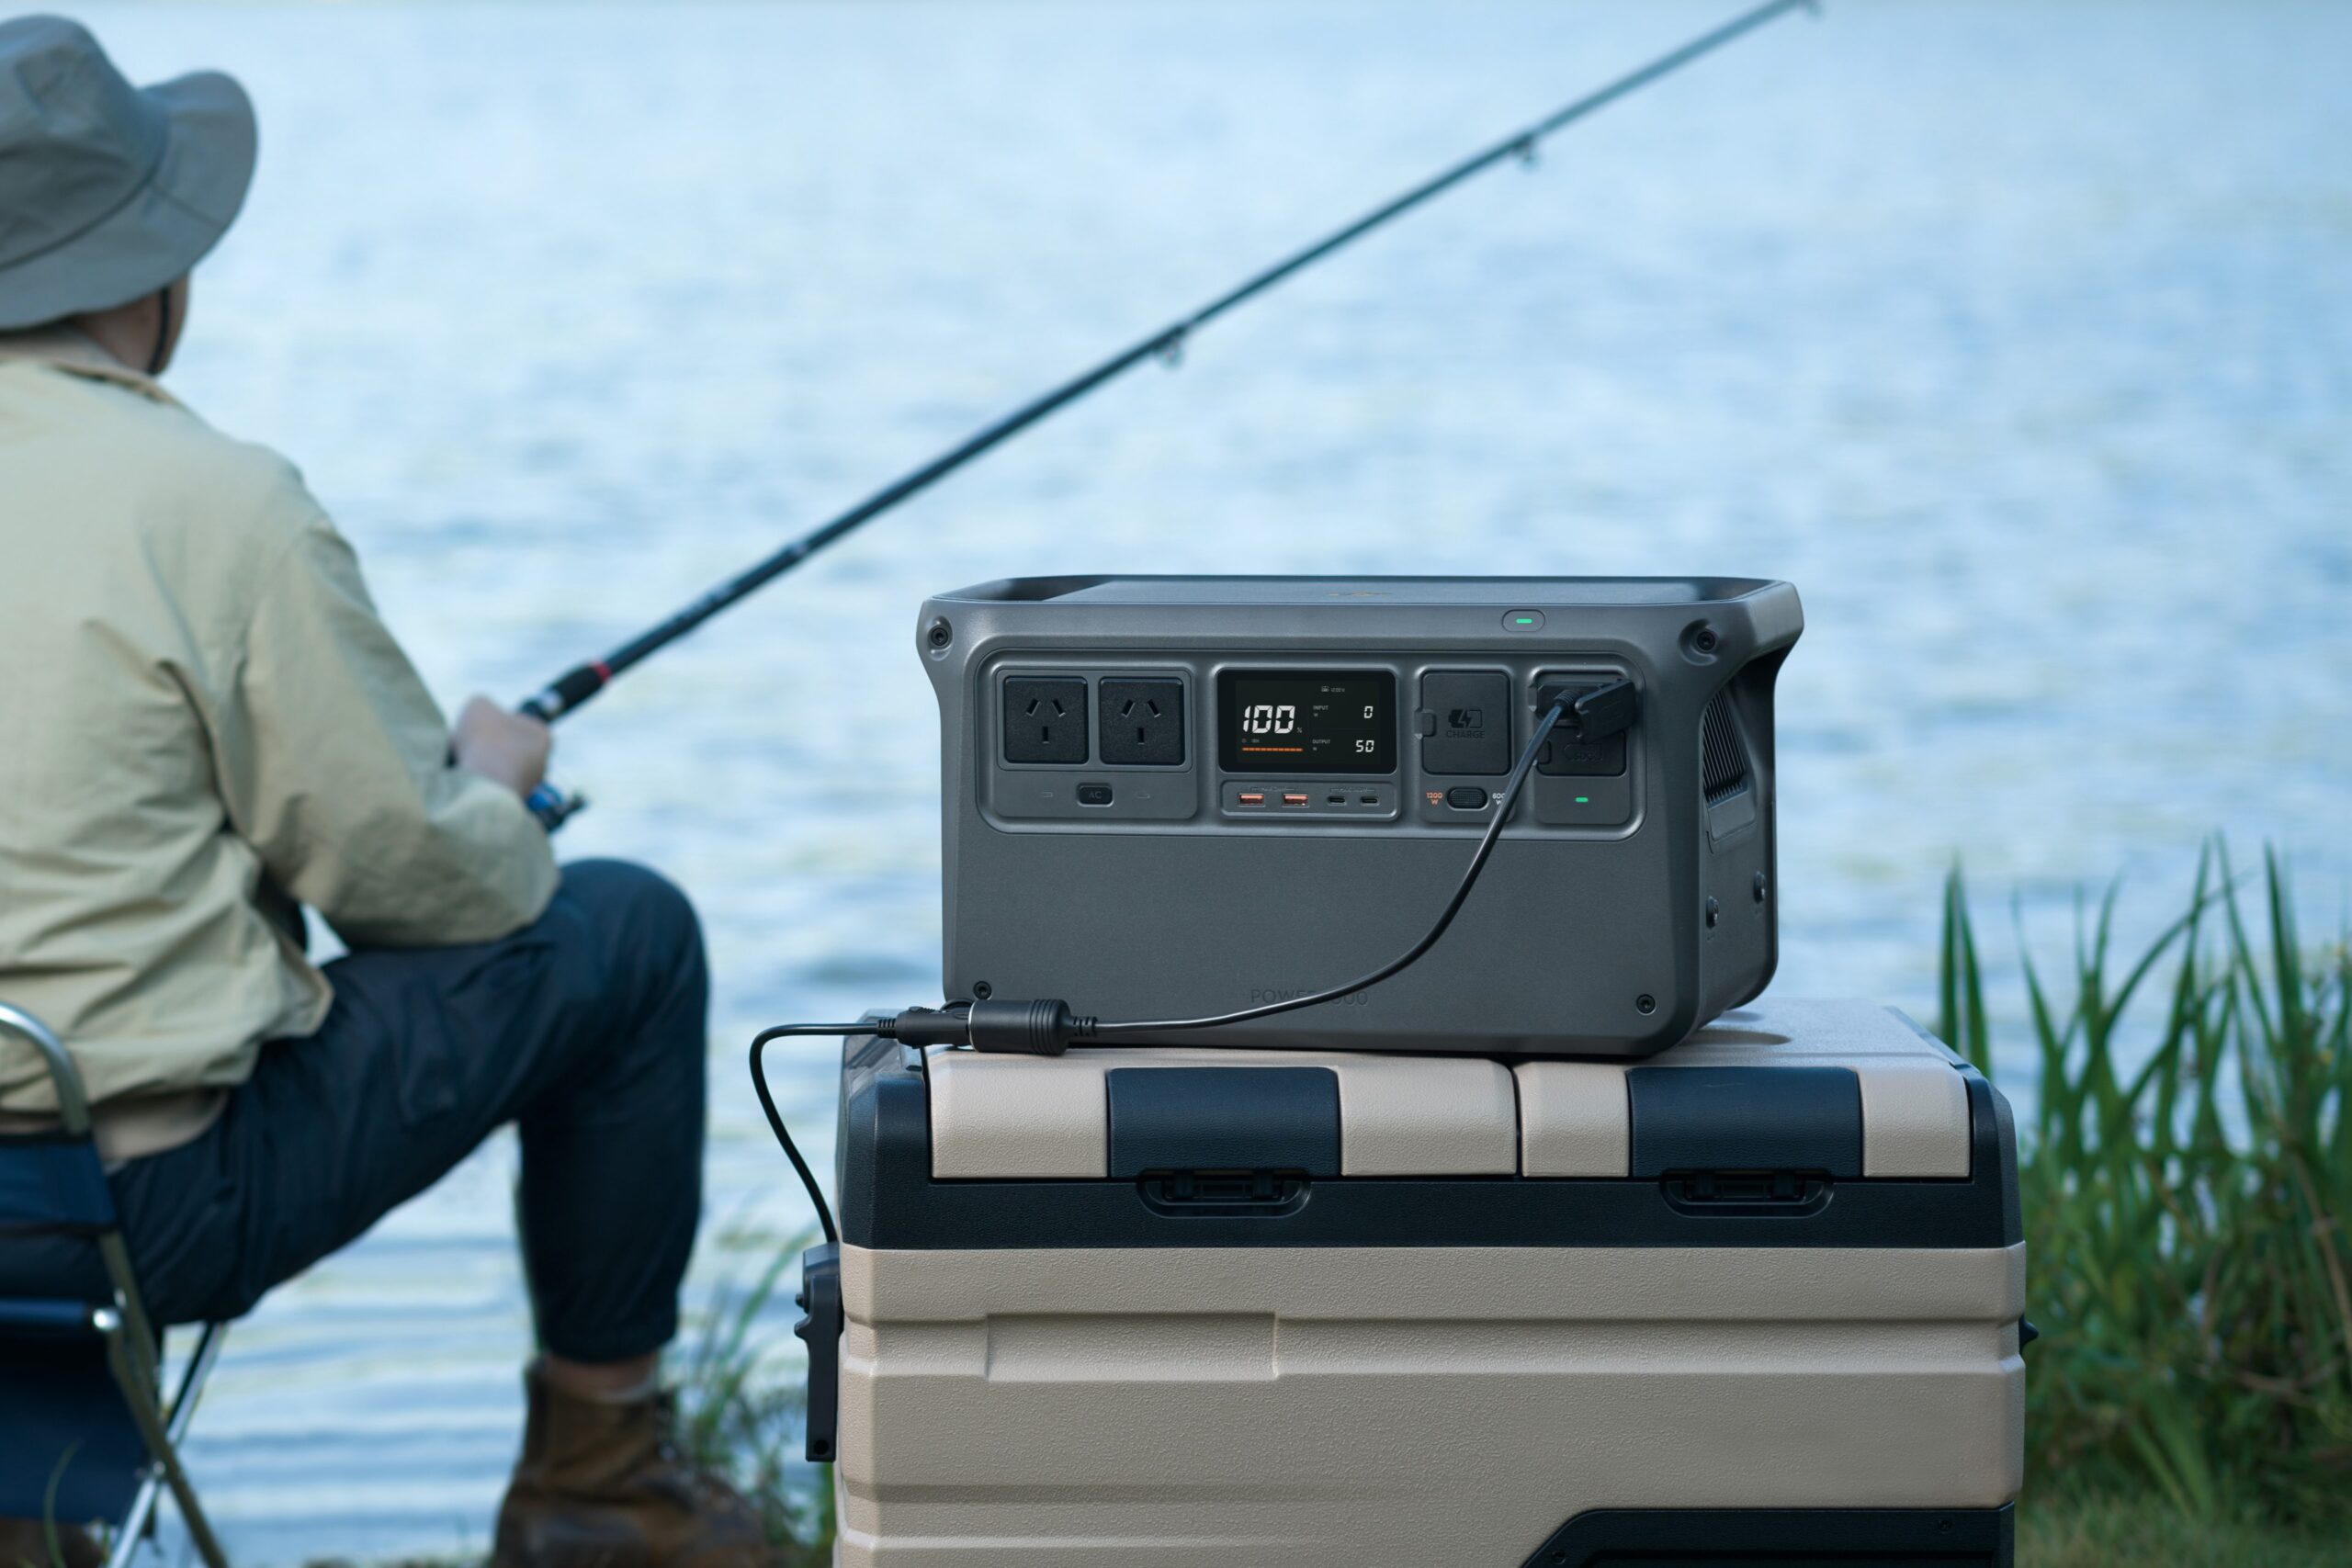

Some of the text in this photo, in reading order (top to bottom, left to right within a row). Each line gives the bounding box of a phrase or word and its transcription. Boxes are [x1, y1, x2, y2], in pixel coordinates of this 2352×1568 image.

[1363, 705, 1374, 718] 0
[1243, 705, 1295, 734] 100
[1447, 730, 1486, 739] CHARGE
[1355, 739, 1374, 752] 50
[1088, 791, 1102, 799] AC
[1250, 989, 1317, 1004] POWE
